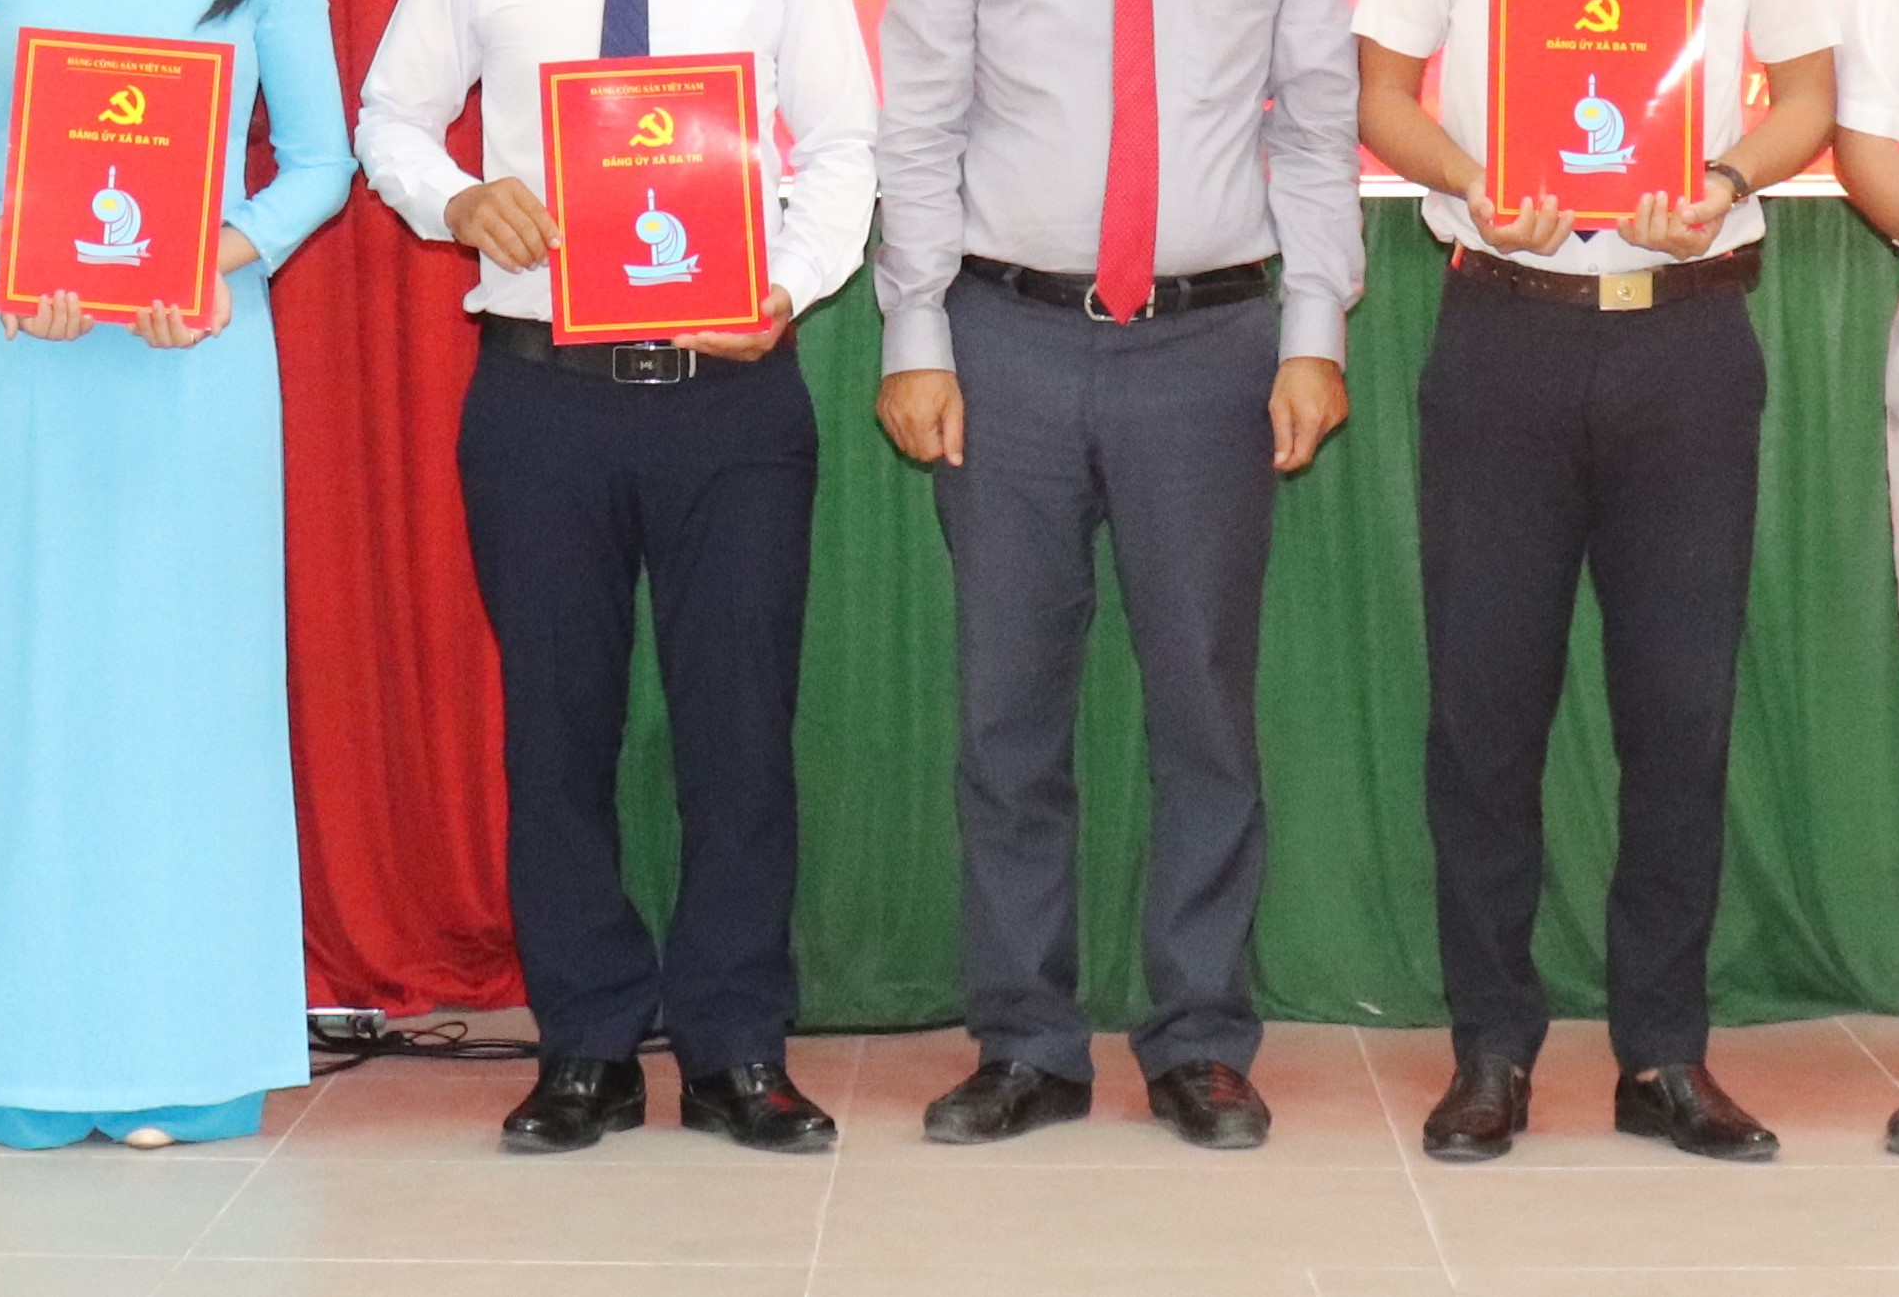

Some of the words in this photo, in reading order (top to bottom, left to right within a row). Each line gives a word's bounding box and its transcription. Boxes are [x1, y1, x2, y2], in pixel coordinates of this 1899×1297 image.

[1547, 38, 1576, 50] ĐẢNG
[1579, 39, 1592, 50] ỦY
[1596, 39, 1610, 51] XÃ
[1613, 42, 1627, 51] BA
[1630, 42, 1647, 51] TRI
[161, 65, 182, 74] NAM
[69, 128, 99, 140] ĐẢNG
[102, 130, 116, 142] ỦY
[119, 132, 132, 143] XÃ
[135, 135, 150, 145] BA
[153, 136, 169, 146] TRI
[602, 155, 632, 167] ĐẢNG
[635, 155, 649, 165] ỦY
[652, 154, 666, 165] XÃ
[669, 155, 684, 164] BA
[686, 154, 703, 163] TRI
